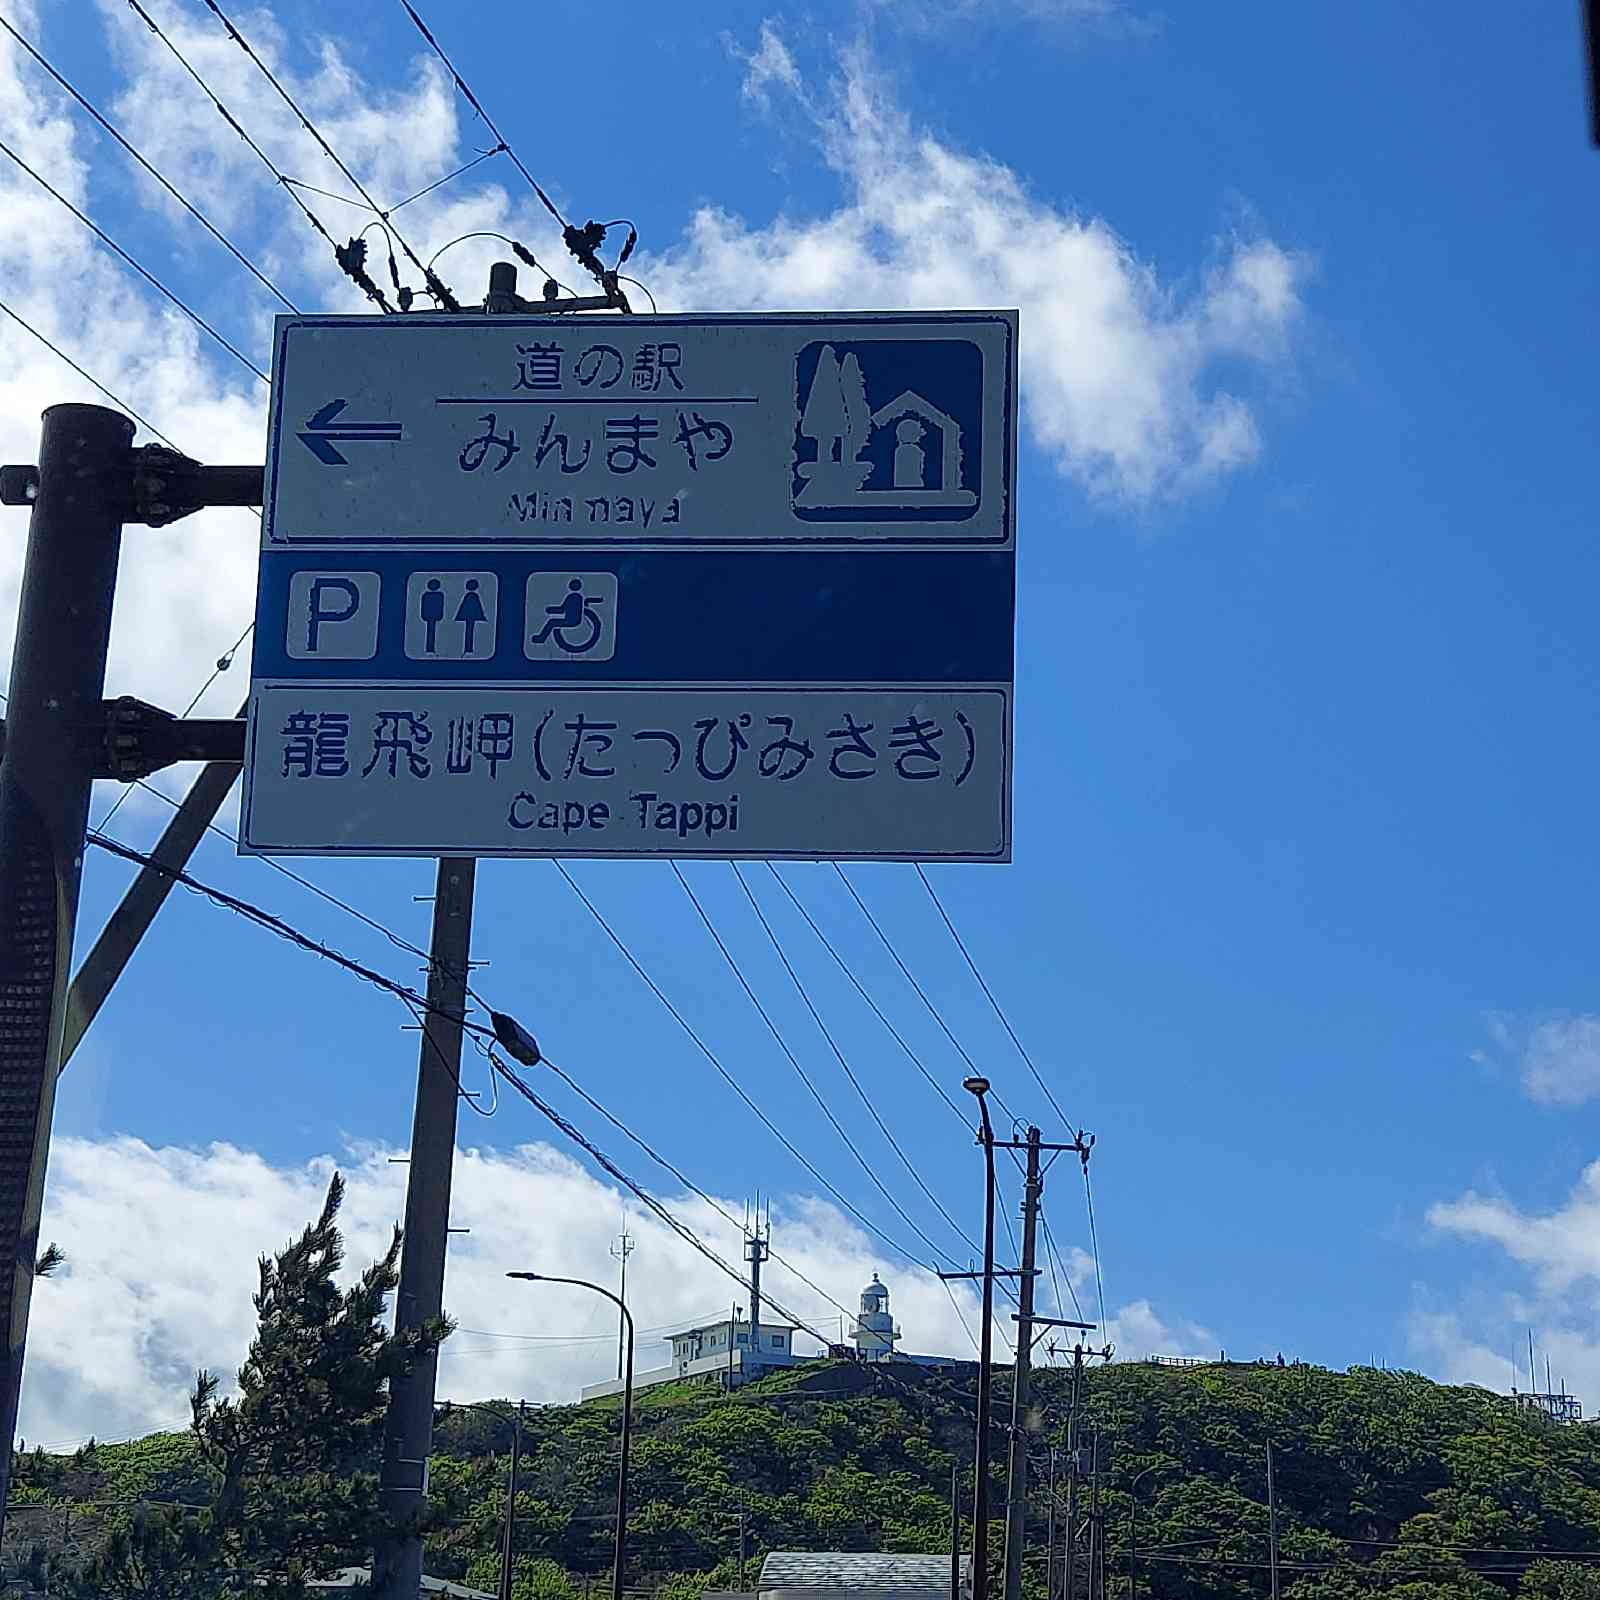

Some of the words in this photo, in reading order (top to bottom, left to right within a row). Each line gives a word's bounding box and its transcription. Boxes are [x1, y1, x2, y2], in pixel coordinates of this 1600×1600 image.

[512, 342, 684, 391] 道の駅
[458, 412, 733, 474] みんまや
[305, 577, 361, 652] P
[507, 791, 610, 835] Cape
[629, 791, 739, 838] Tappi
